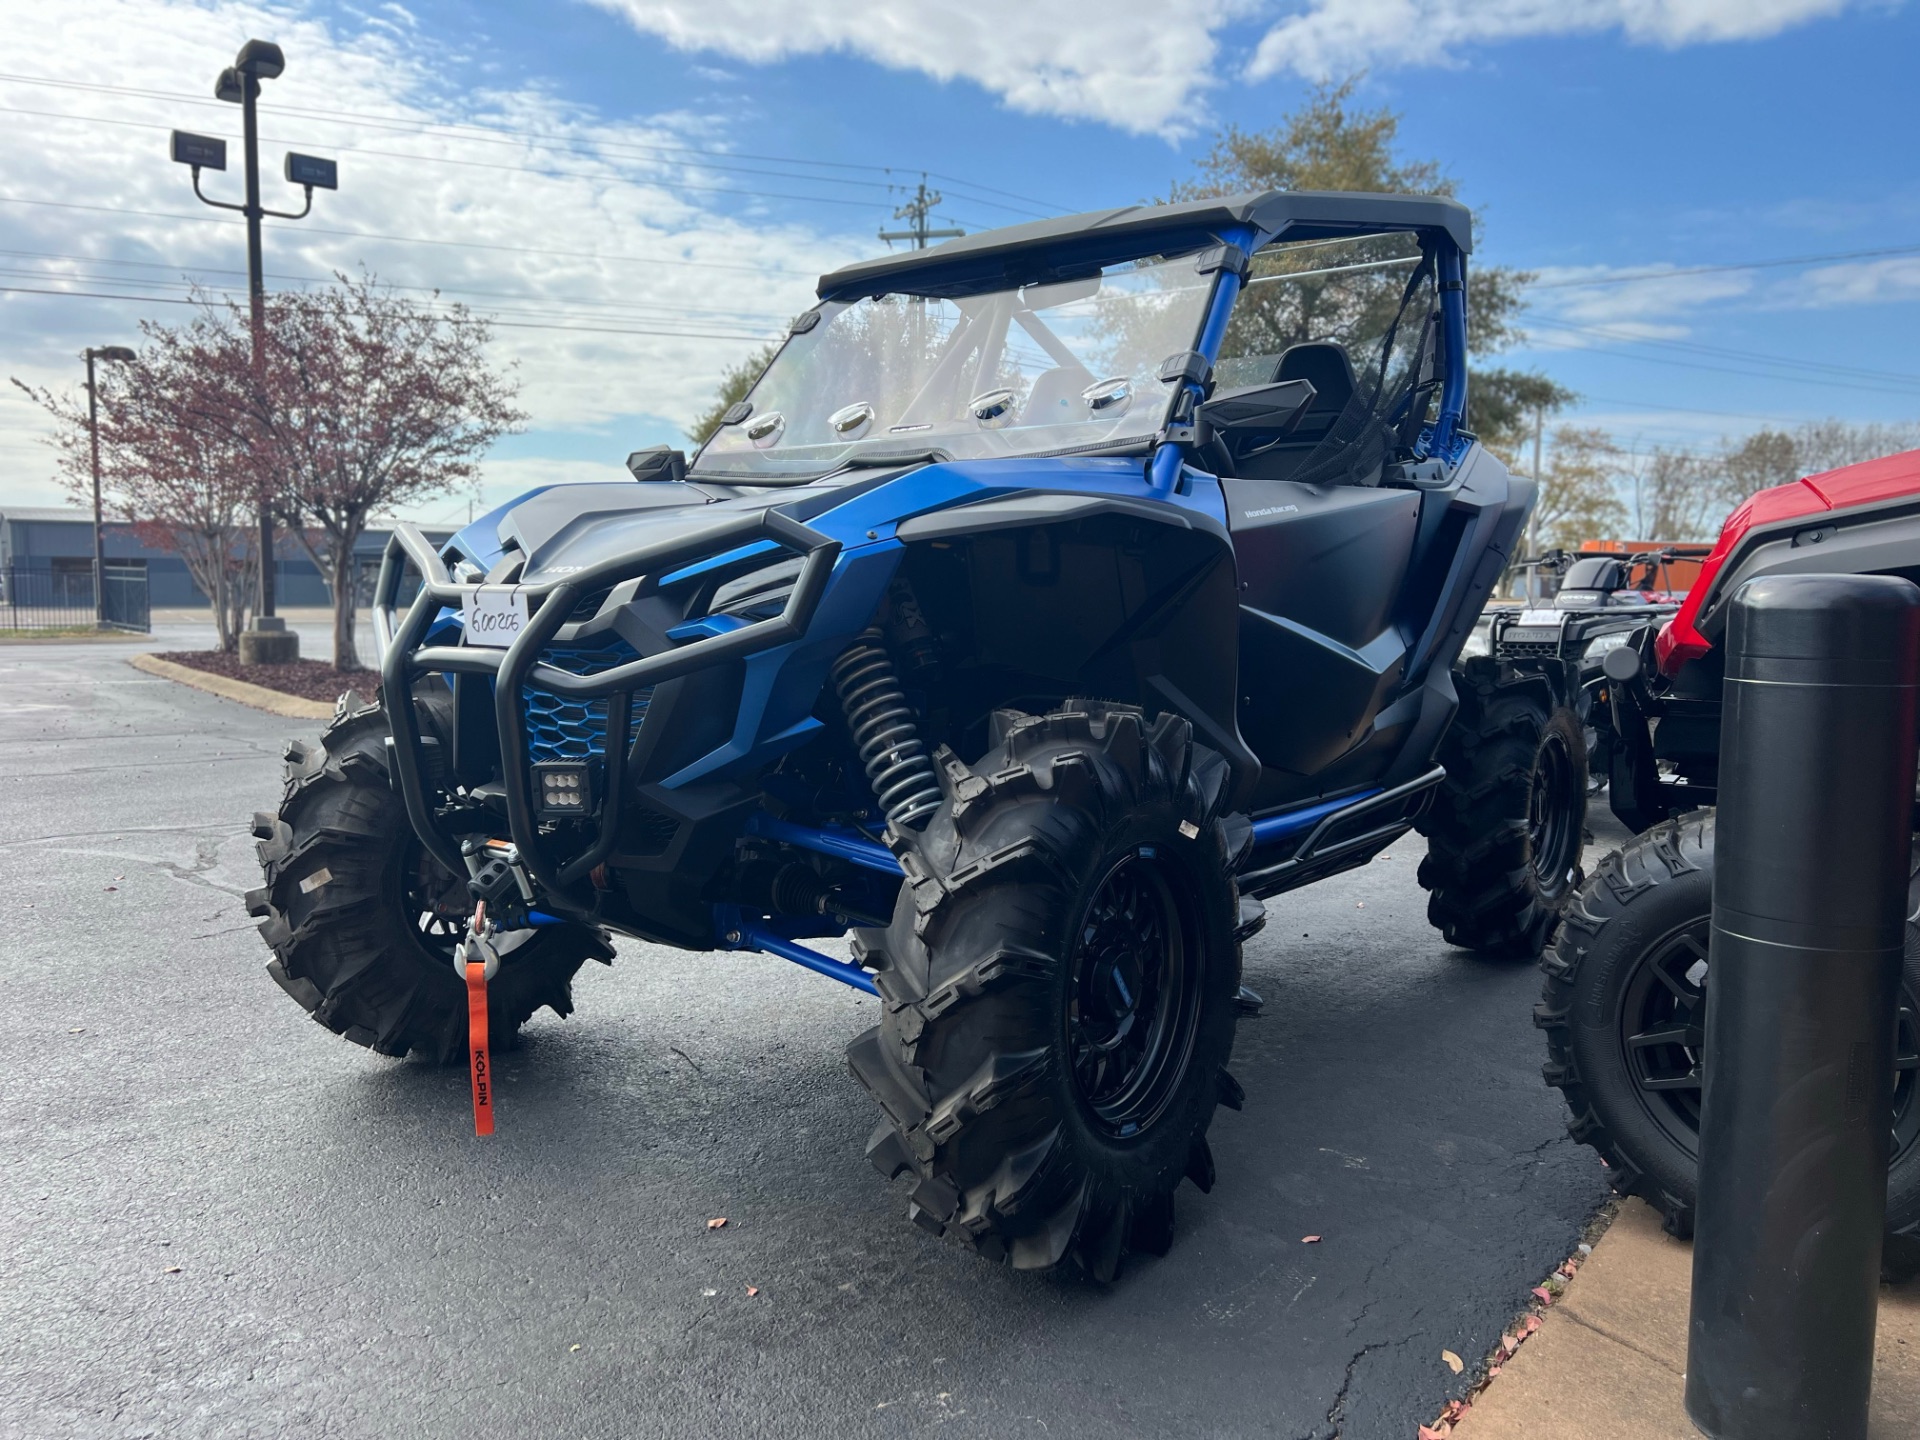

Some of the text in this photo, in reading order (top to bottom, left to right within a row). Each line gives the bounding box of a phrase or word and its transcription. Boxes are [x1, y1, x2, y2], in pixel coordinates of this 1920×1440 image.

[1244, 508, 1272, 518] Honda
[1508, 631, 1552, 639] HONDA
[475, 1050, 488, 1106] KOLPIN
